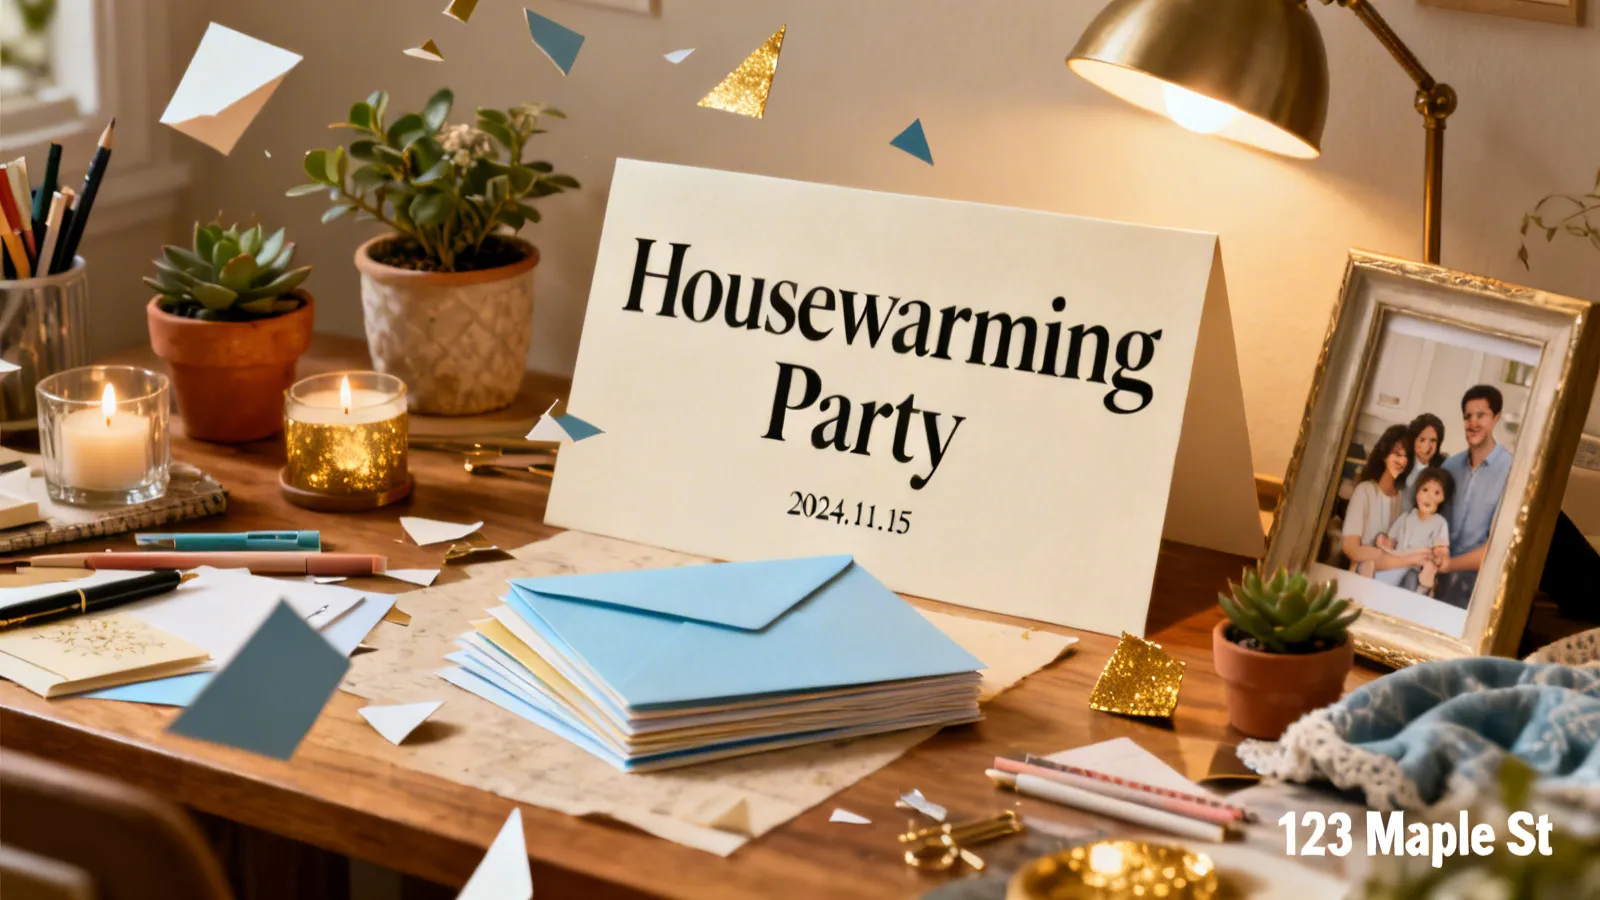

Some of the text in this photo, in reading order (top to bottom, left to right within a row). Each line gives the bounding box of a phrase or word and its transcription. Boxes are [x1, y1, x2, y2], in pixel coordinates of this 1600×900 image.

[621, 237, 1163, 415] Housewarming
[760, 361, 967, 491] Party
[786, 490, 913, 535] 2024.11.15
